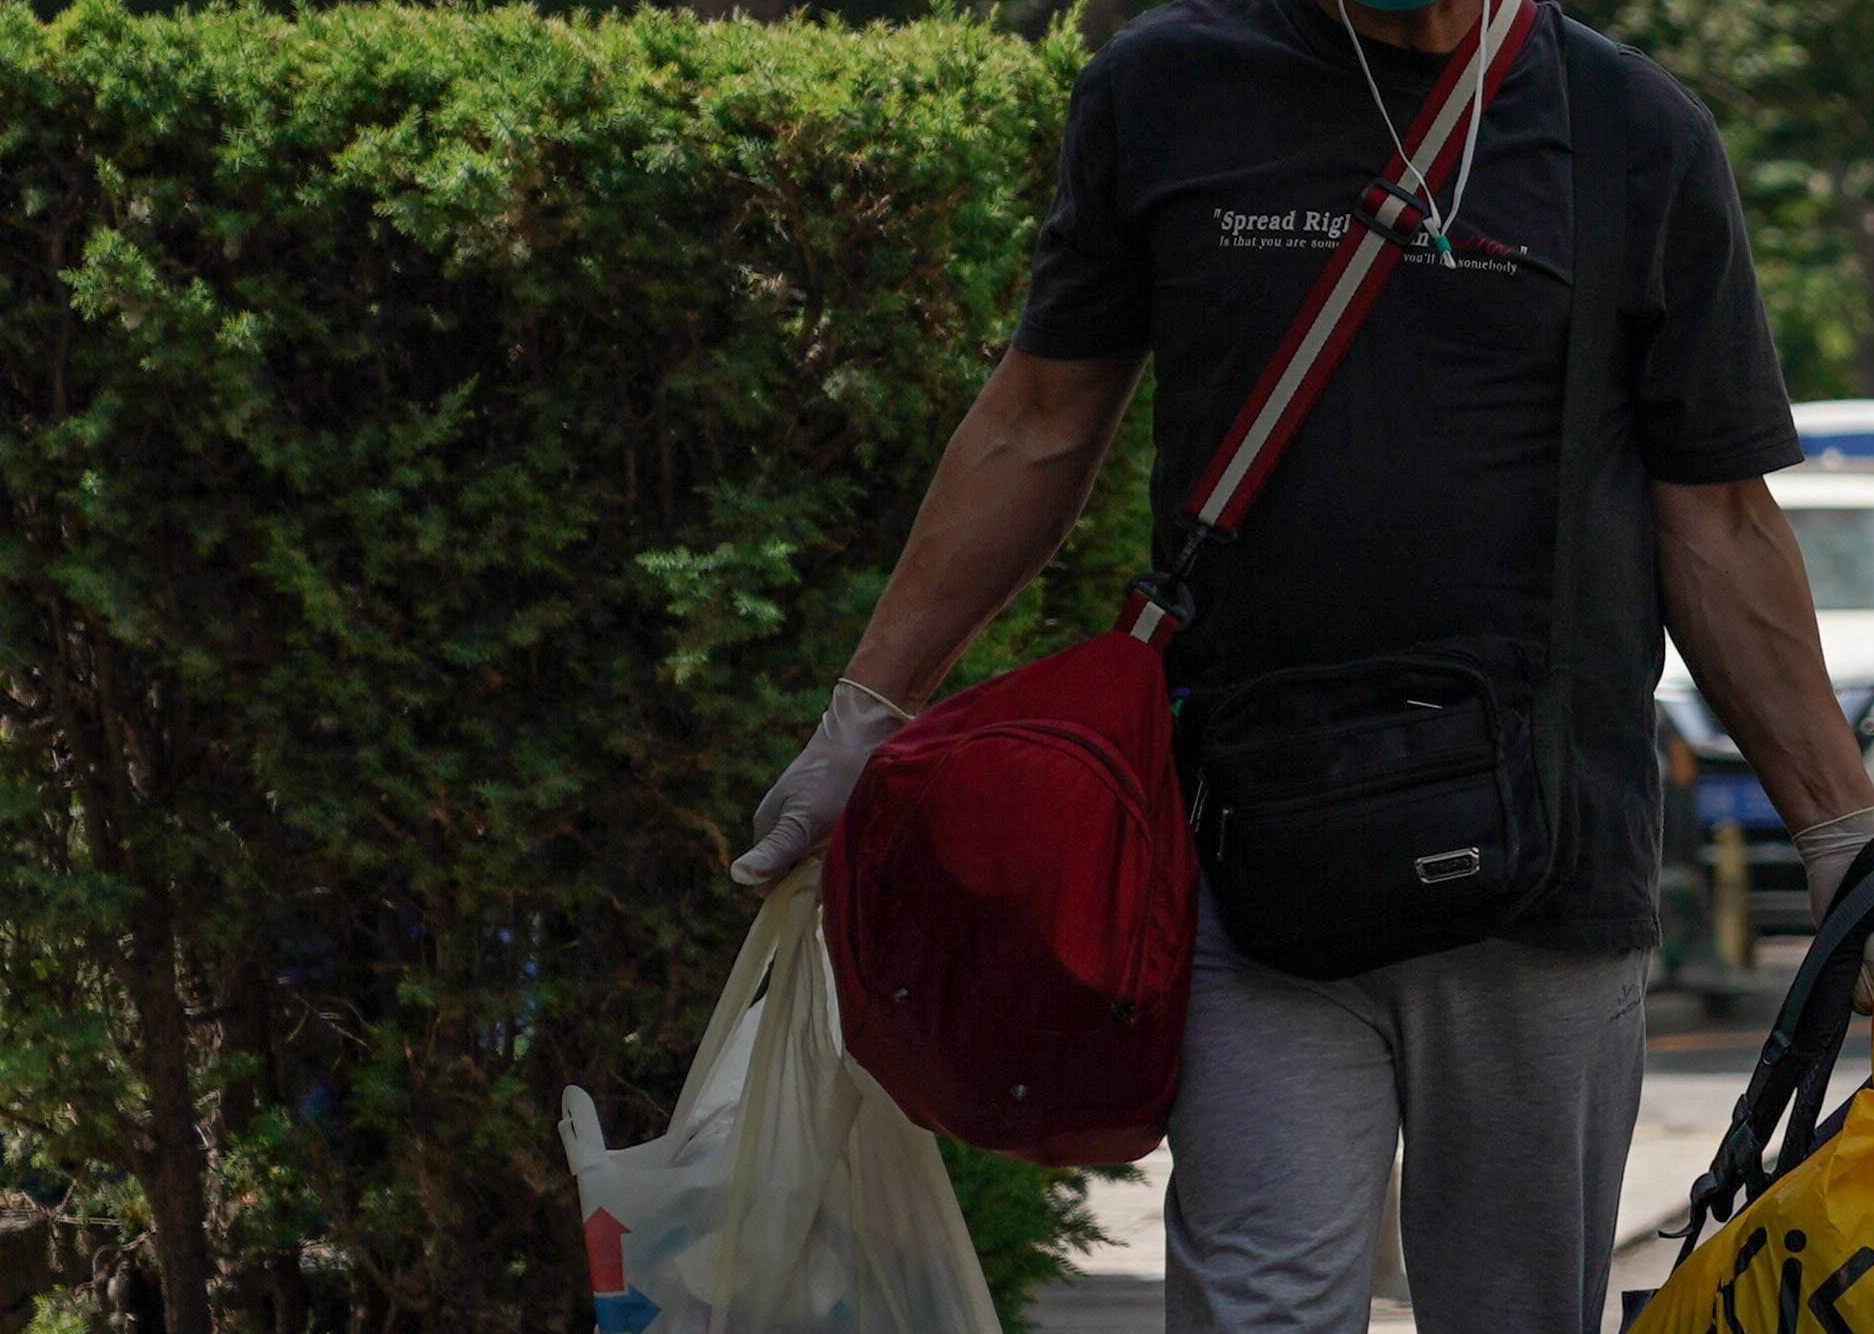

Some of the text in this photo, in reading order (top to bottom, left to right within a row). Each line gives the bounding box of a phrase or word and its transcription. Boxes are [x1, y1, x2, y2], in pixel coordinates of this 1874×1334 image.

[1259, 234, 1283, 249] you
[1286, 236, 1307, 249] are
[1456, 258, 1519, 275] somebody
